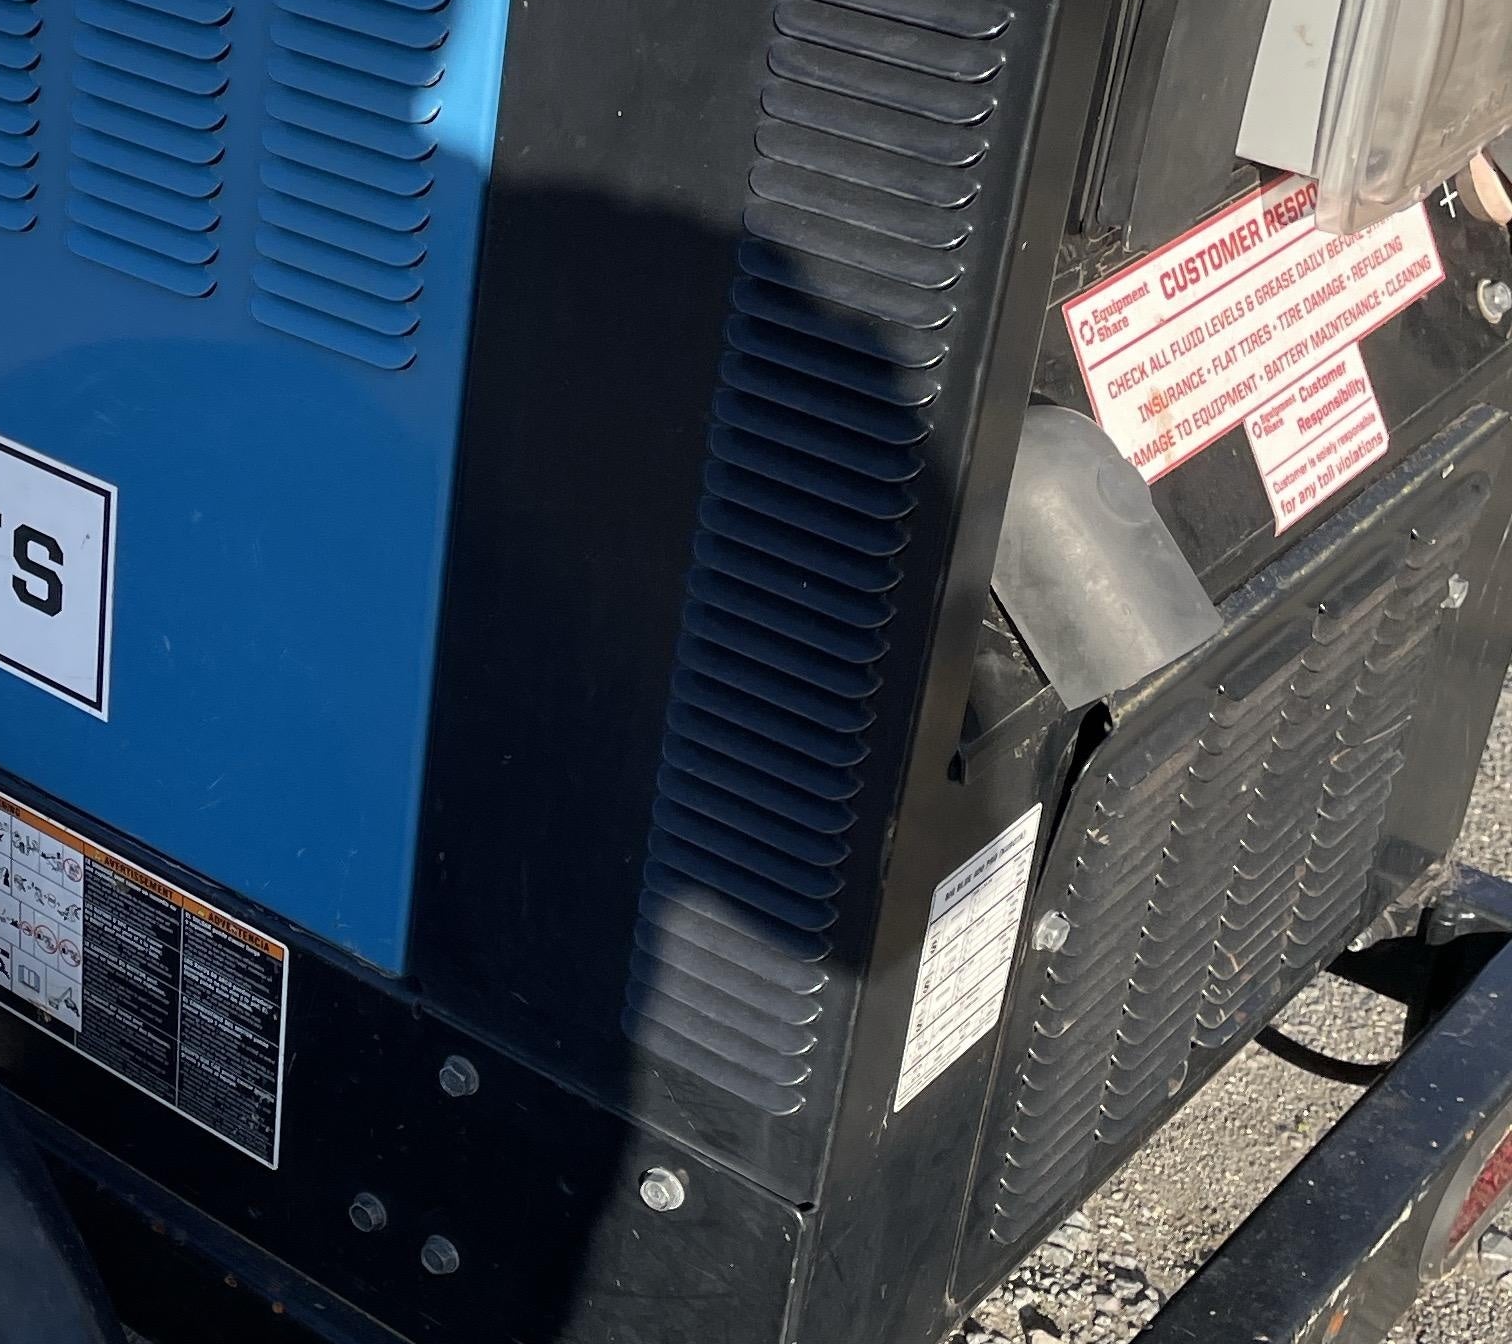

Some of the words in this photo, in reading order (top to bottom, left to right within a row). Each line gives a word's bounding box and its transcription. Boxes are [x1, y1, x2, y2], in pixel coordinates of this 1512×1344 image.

[1159, 218, 1263, 300] CUSTOMER
[1263, 182, 1318, 238] RESPO
[1091, 281, 1150, 326] Equipment
[1096, 315, 1130, 343] Share
[1107, 361, 1149, 400] CHECK
[1149, 349, 1171, 375] ALL
[1170, 326, 1205, 361] FLUID
[1205, 301, 1245, 338] LEVELS
[1254, 268, 1296, 307] GREASE
[1295, 248, 1326, 280] DAILY
[1137, 367, 1207, 424] INSURANCE
[1212, 346, 1239, 376] FLAT
[1238, 324, 1273, 357] TIRES
[1277, 303, 1304, 332] TIRE
[1303, 274, 1347, 315] DAMAGE
[1350, 235, 1403, 283] REFUELING
[1175, 418, 1193, 441] TO
[1192, 374, 1258, 431] EQUIPMENT
[1264, 338, 1310, 382] BATTERY
[1309, 290, 1382, 350] MAINTENANCE
[1385, 254, 1432, 297] CLEANING
[1299, 360, 1347, 403] Customer
[1297, 377, 1366, 435] Responsibility
[1272, 463, 1308, 495] Customer
[1280, 496, 1296, 517] for
[1298, 481, 1317, 505] any
[1316, 464, 1336, 489] toll
[1336, 432, 1384, 475] violations
